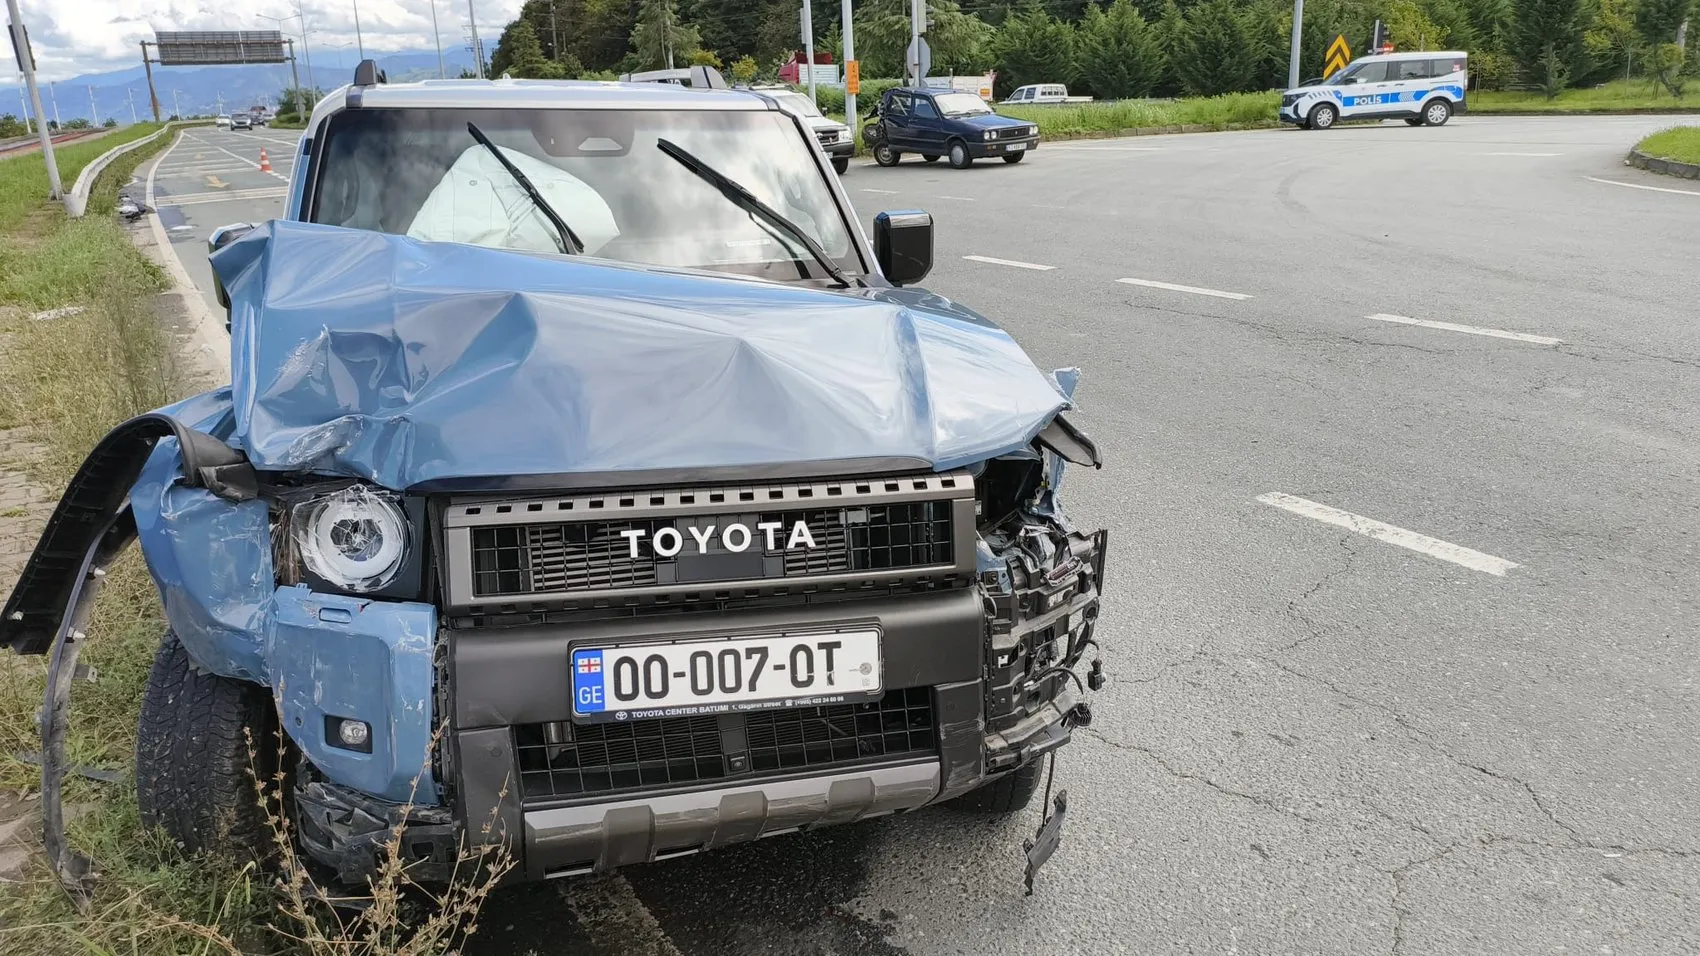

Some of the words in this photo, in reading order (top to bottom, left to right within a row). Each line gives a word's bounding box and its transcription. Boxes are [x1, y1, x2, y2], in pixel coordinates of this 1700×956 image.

[620, 520, 816, 559] TOYOTA
[613, 641, 842, 702] 00-007-OT
[579, 685, 602, 704] GE
[631, 710, 664, 718] TOYOTA
[665, 707, 698, 716] CENTER
[699, 704, 729, 713] BATUMI
